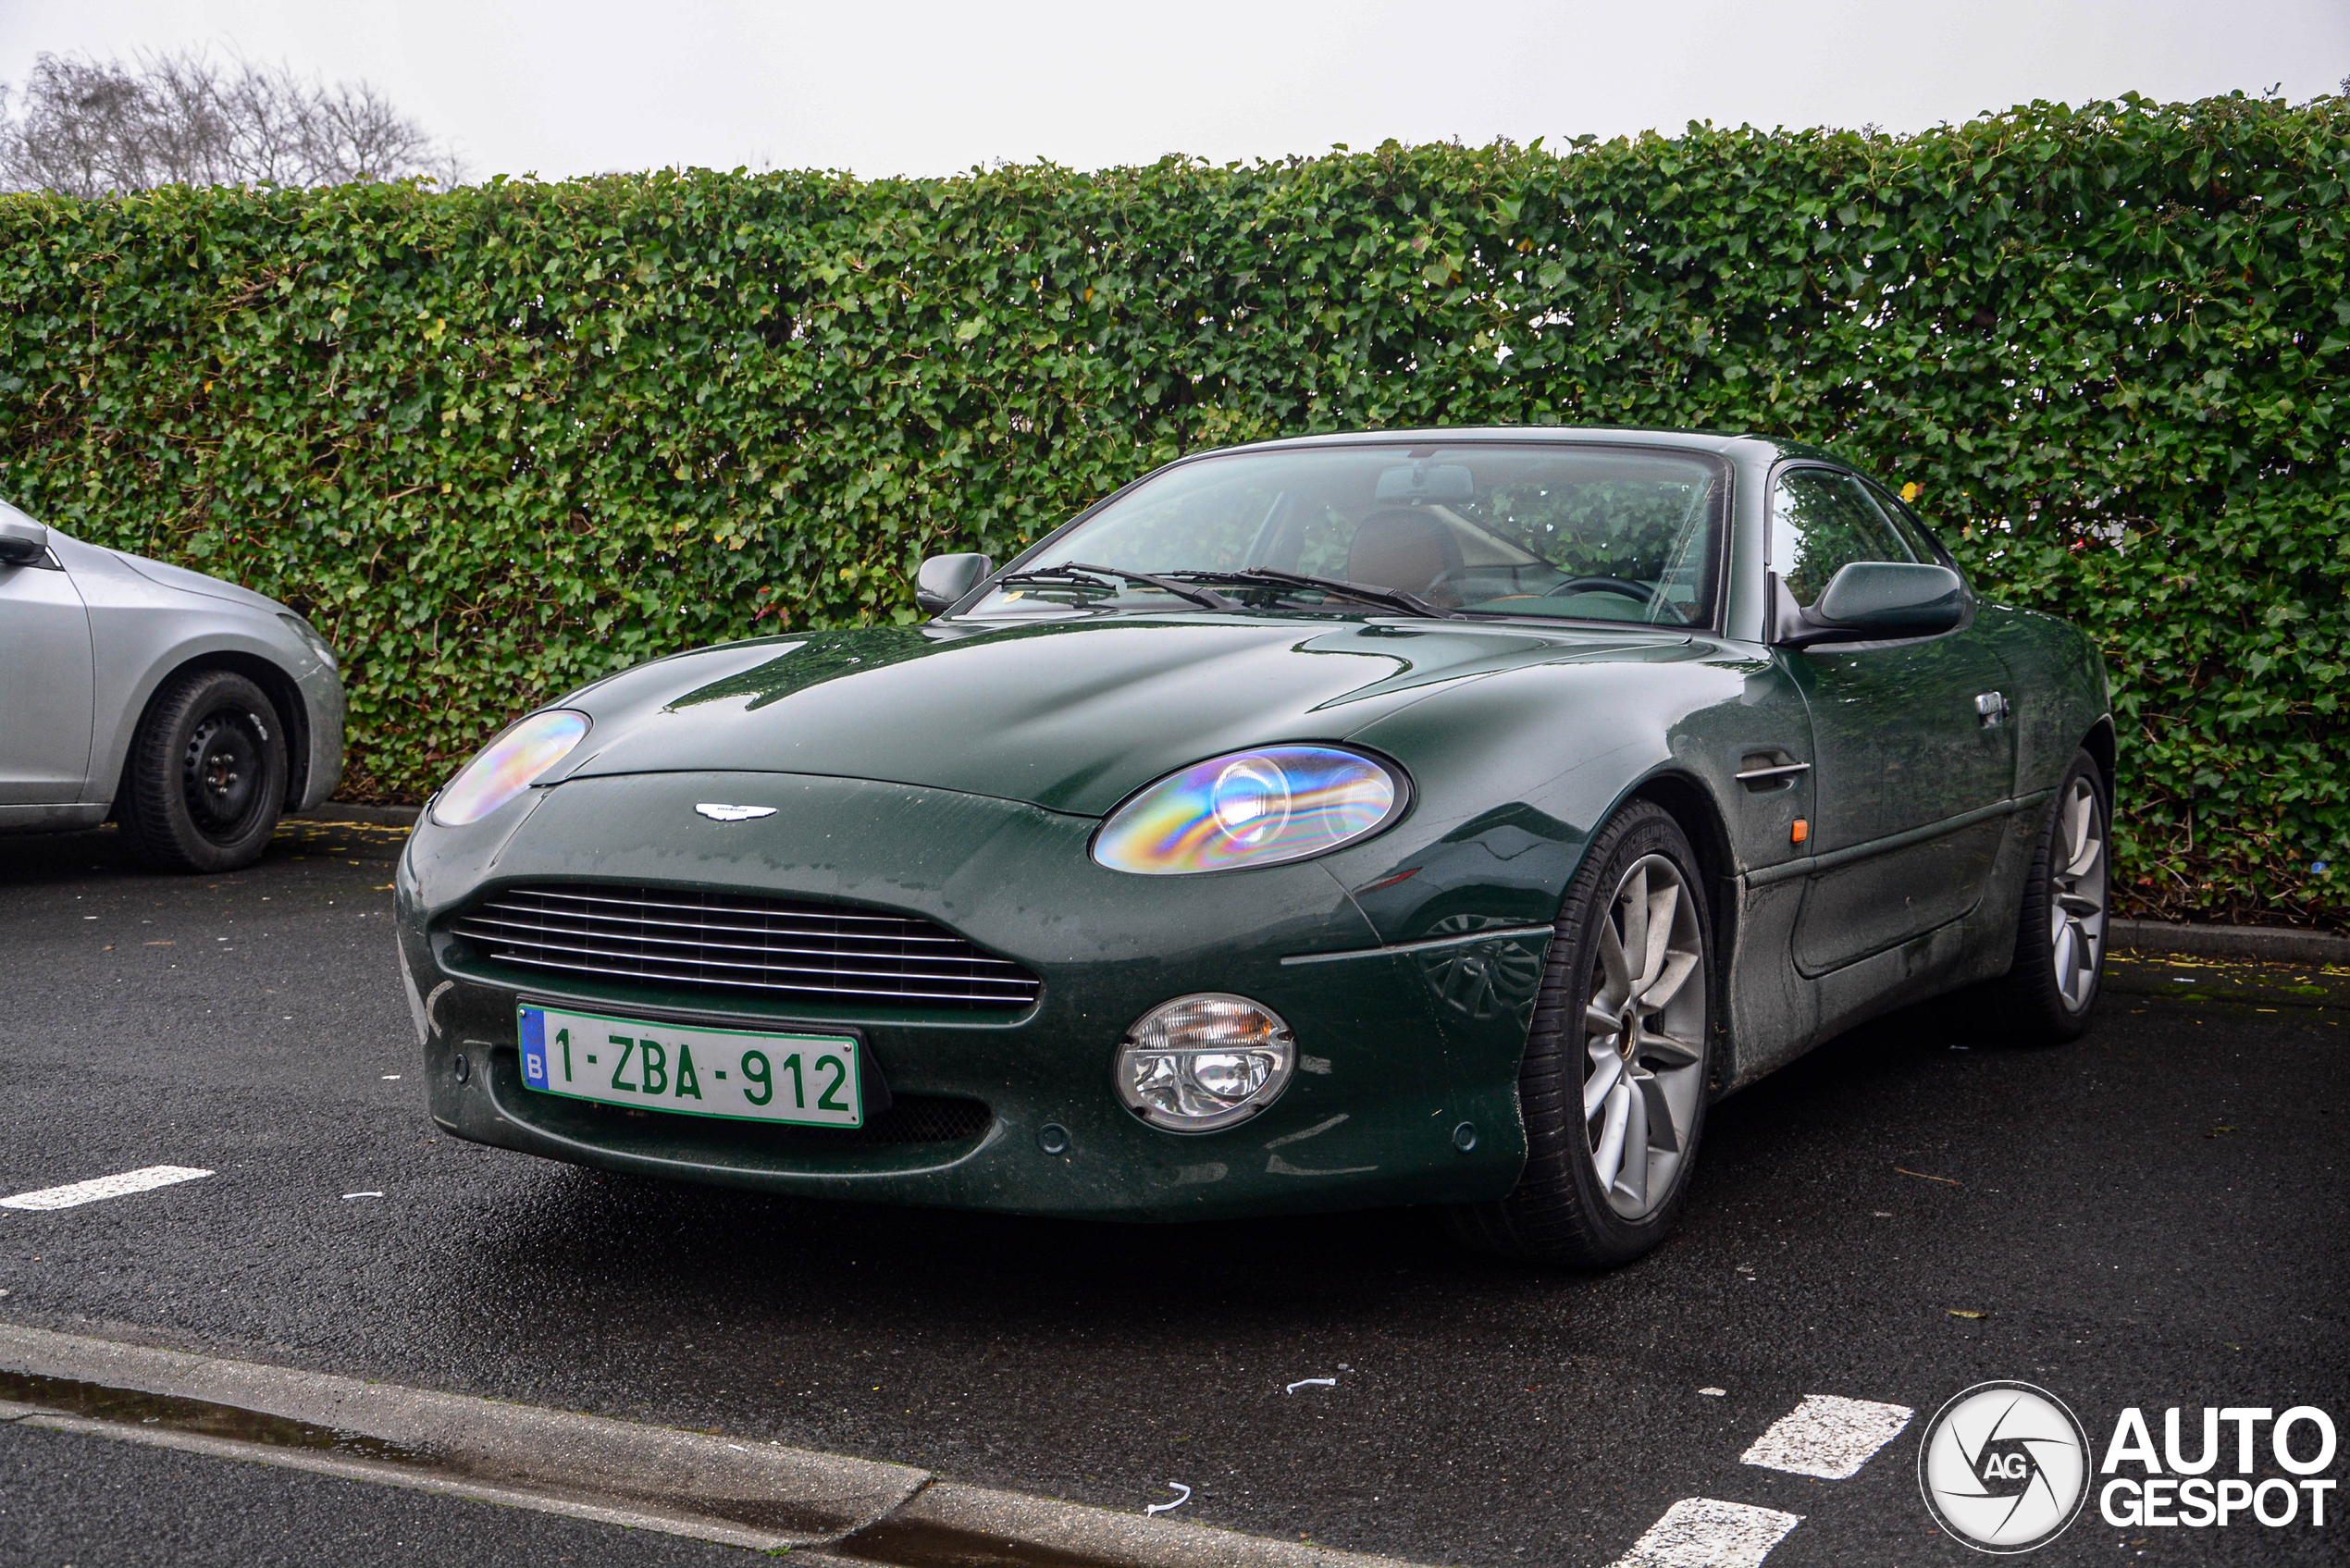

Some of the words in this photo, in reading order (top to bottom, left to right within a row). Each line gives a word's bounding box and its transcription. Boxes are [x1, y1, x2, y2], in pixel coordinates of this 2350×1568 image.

[1619, 824, 1661, 865] MICHELIN
[527, 1054, 543, 1080] B
[554, 1027, 850, 1112] 1-ZBA-912
